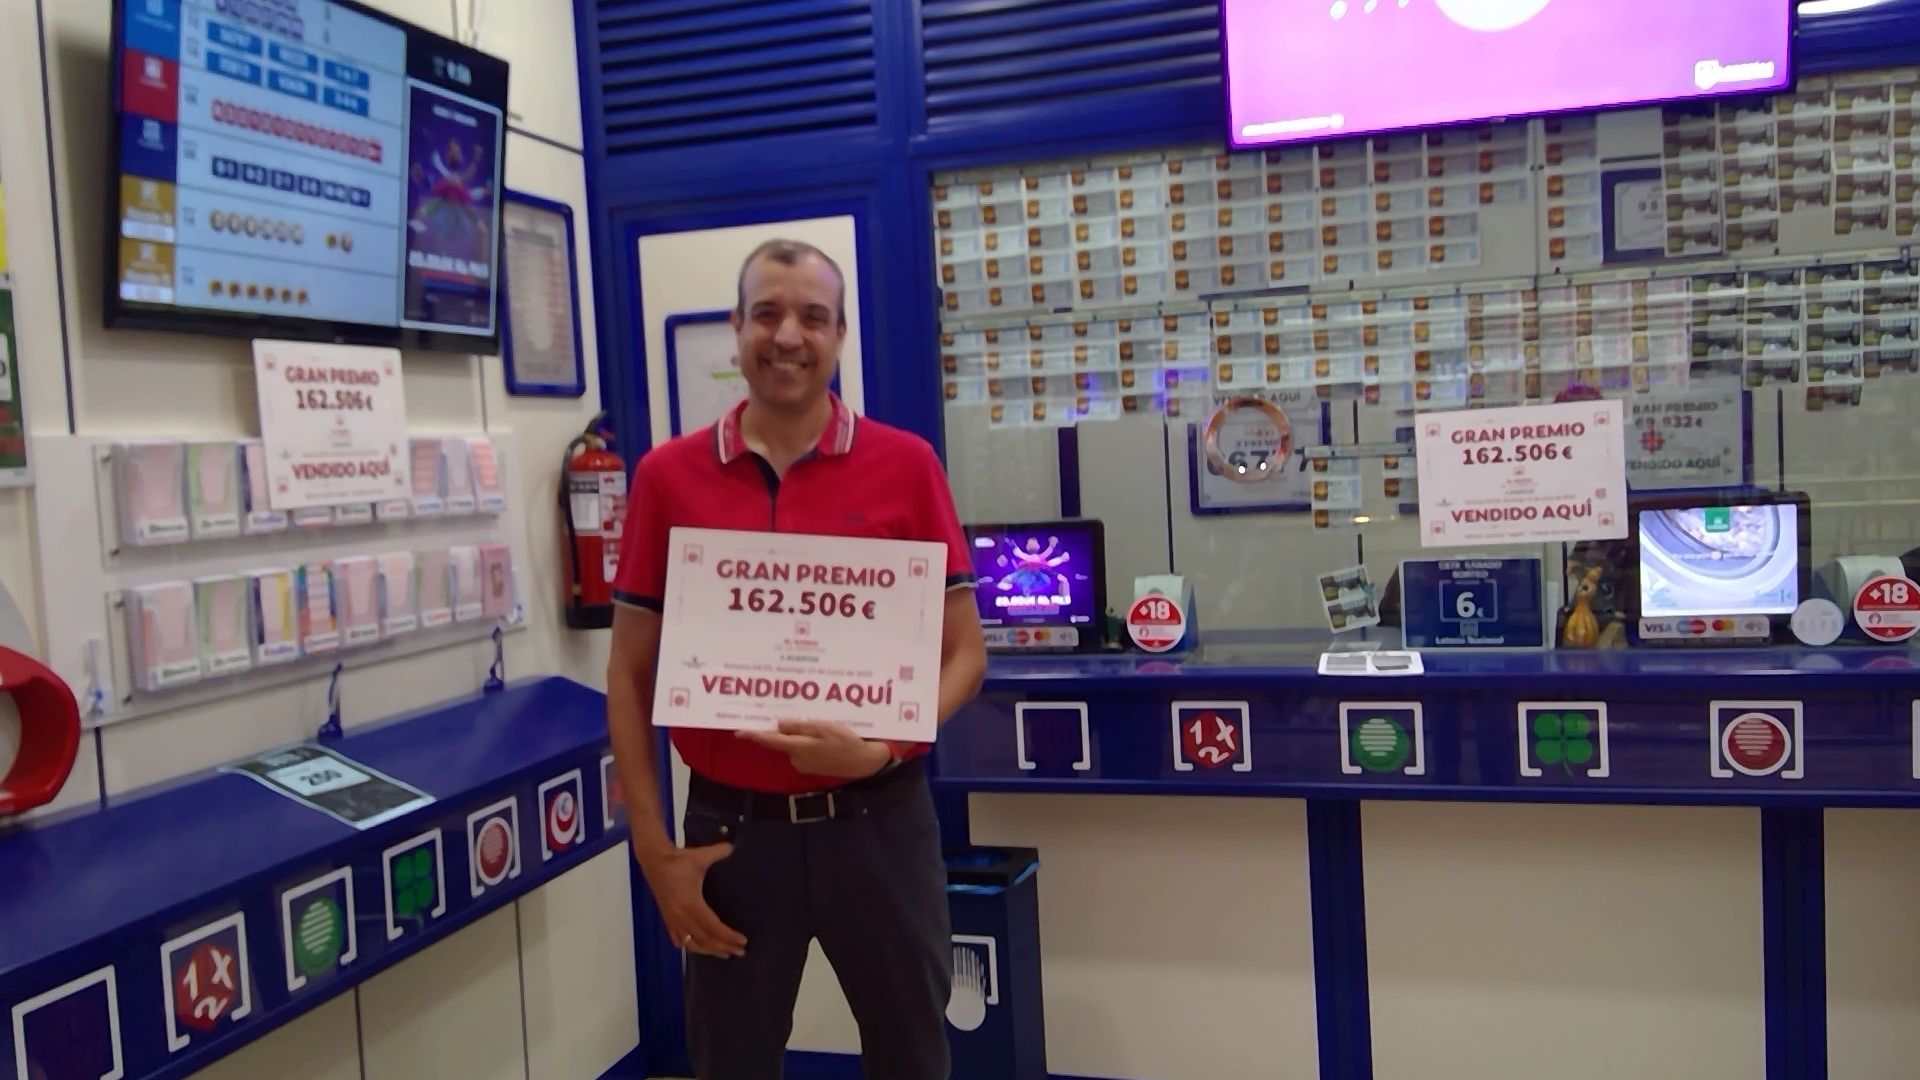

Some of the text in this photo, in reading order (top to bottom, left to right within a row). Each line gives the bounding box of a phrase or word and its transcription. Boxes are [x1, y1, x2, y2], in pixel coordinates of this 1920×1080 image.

[284, 366, 380, 386] GRAN PREMIO
[1450, 421, 1586, 445] GRAN PREMIO
[1462, 443, 1573, 465] 162.506€
[291, 455, 391, 481] VENDIDO AQUÍ
[1450, 506, 1538, 523] VENDIDO
[1542, 497, 1593, 521] AQUÍ
[716, 558, 896, 588] GRAN PREMIO
[727, 587, 876, 620] 162.506€
[1869, 582, 1908, 604] +18
[1139, 601, 1170, 620] +18
[1644, 622, 1672, 634] VISA
[701, 673, 894, 708] VENDIDO AQUÍ
